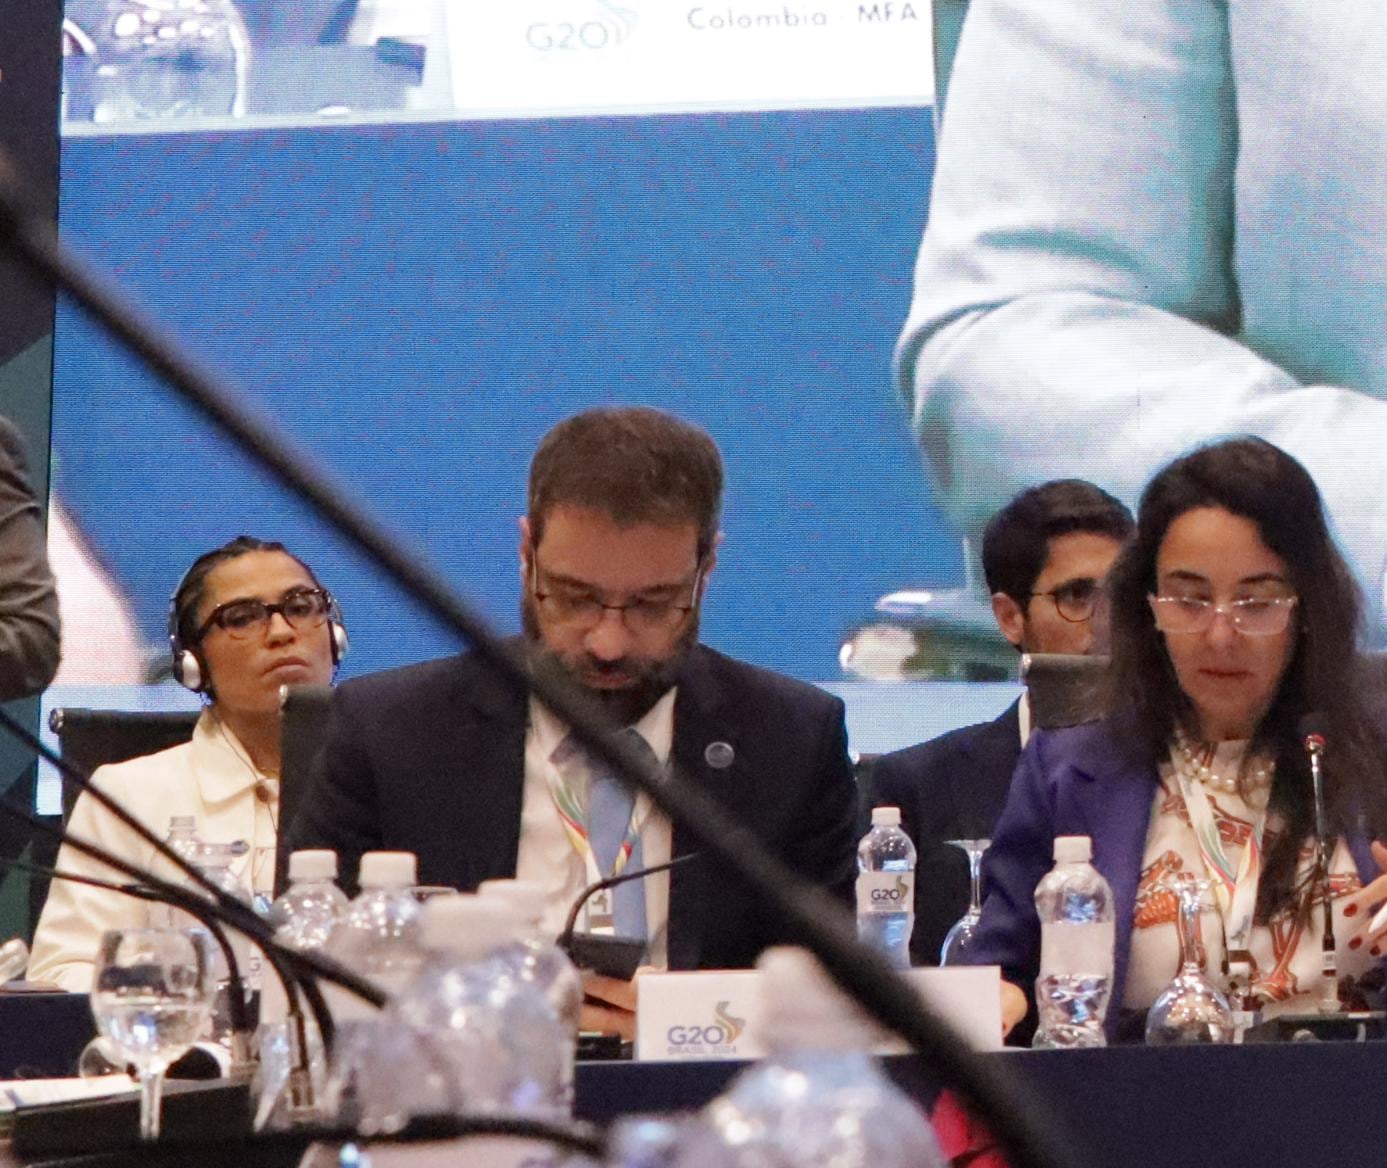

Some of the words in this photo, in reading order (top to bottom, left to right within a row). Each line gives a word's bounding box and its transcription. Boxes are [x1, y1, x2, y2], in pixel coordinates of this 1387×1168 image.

[686, 5, 829, 31] Colombia
[857, 1, 919, 24] MFA
[871, 888, 899, 901] G20
[667, 1025, 725, 1046] G20
